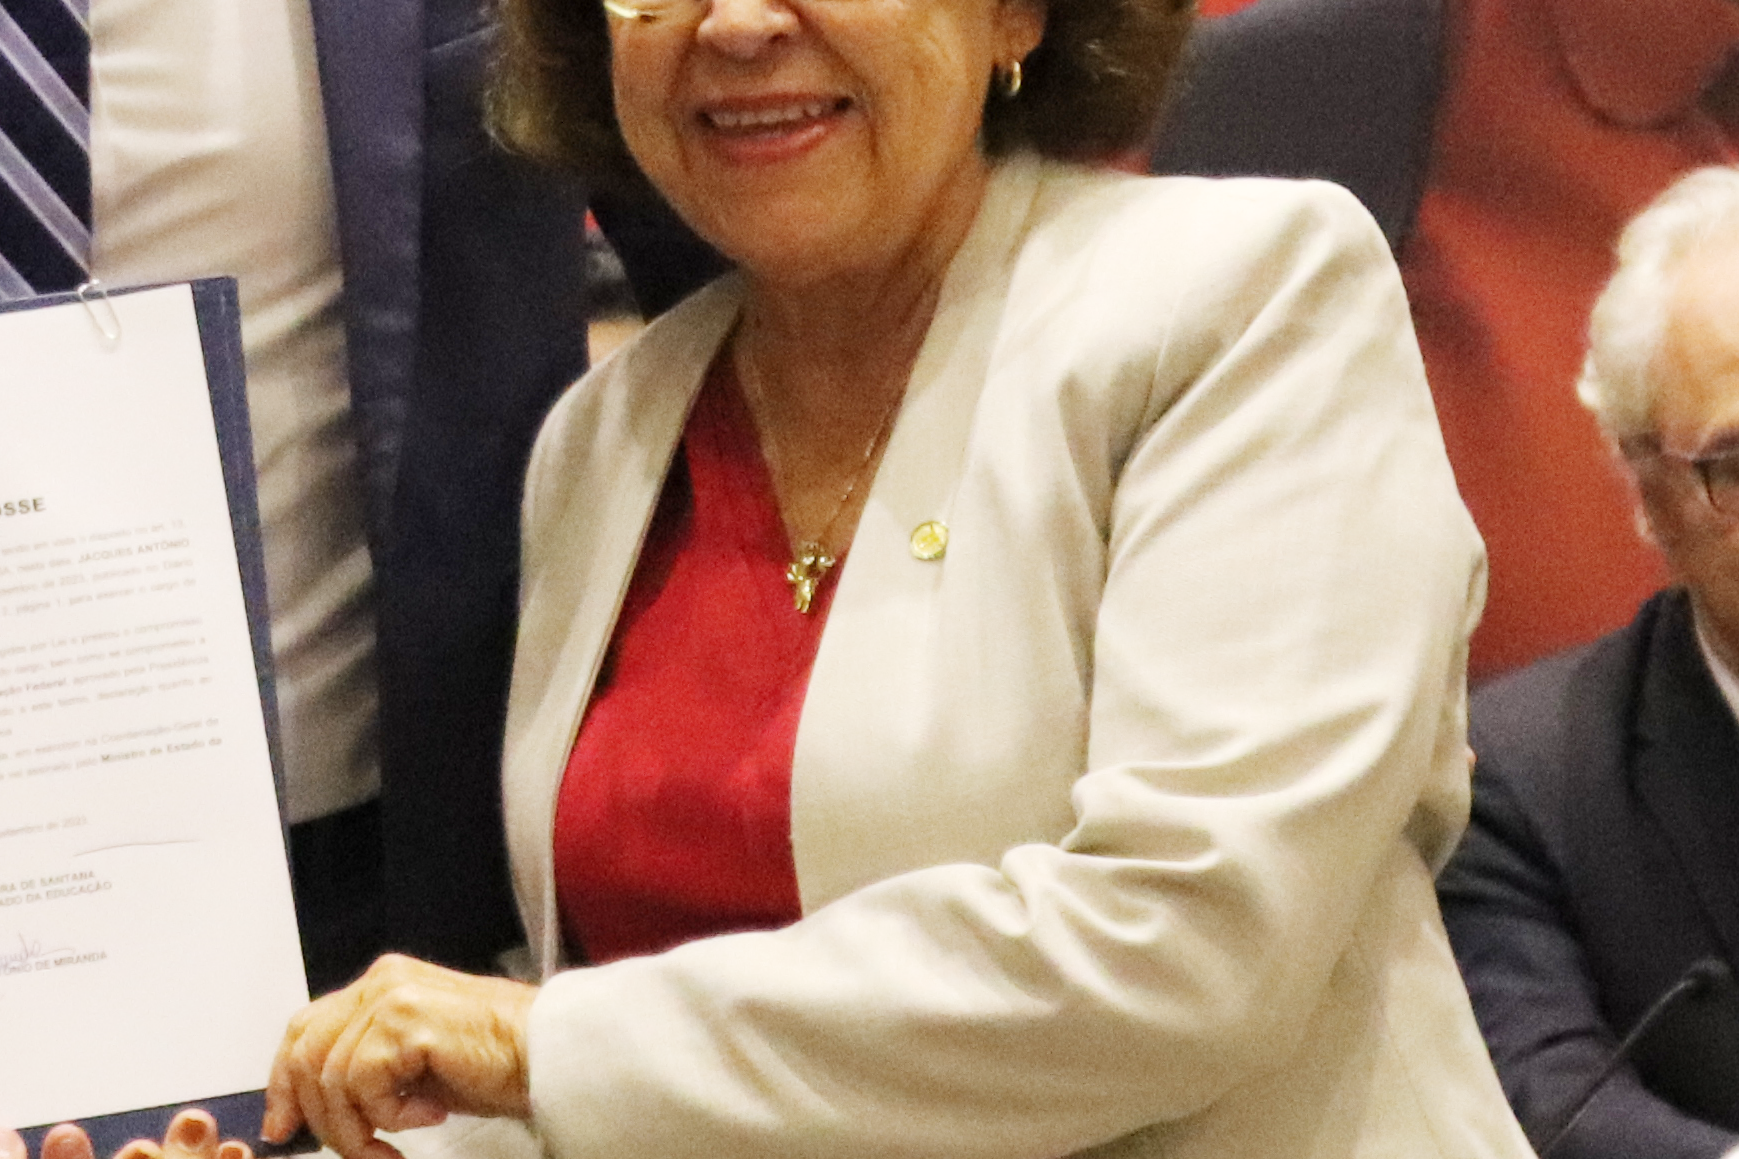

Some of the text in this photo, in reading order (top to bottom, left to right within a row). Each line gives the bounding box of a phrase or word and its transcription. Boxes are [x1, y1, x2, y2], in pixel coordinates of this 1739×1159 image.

[19, 878, 35, 890] DE
[39, 870, 95, 886] SANTANA
[25, 892, 42, 903] DA
